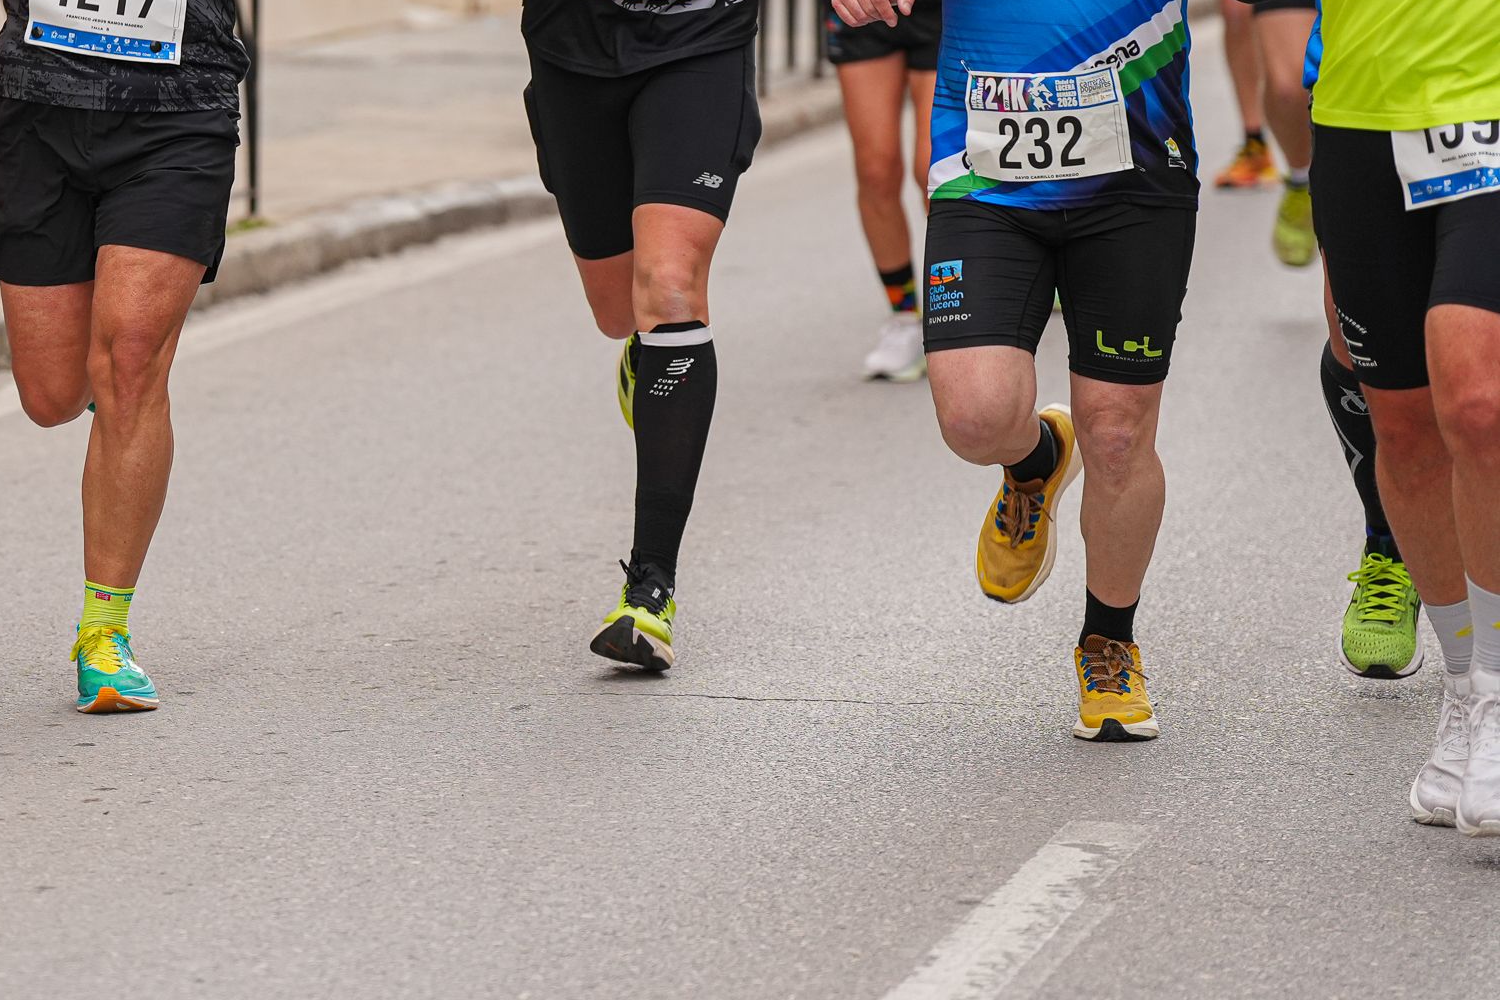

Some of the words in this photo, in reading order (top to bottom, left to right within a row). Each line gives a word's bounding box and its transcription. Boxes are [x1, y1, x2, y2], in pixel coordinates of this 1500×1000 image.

[985, 77, 1029, 111] 21K
[1057, 96, 1077, 108] 2026
[998, 116, 1086, 170] 232
[929, 285, 946, 295] Club
[930, 290, 964, 303] Maratón
[930, 300, 960, 311] Lucena
